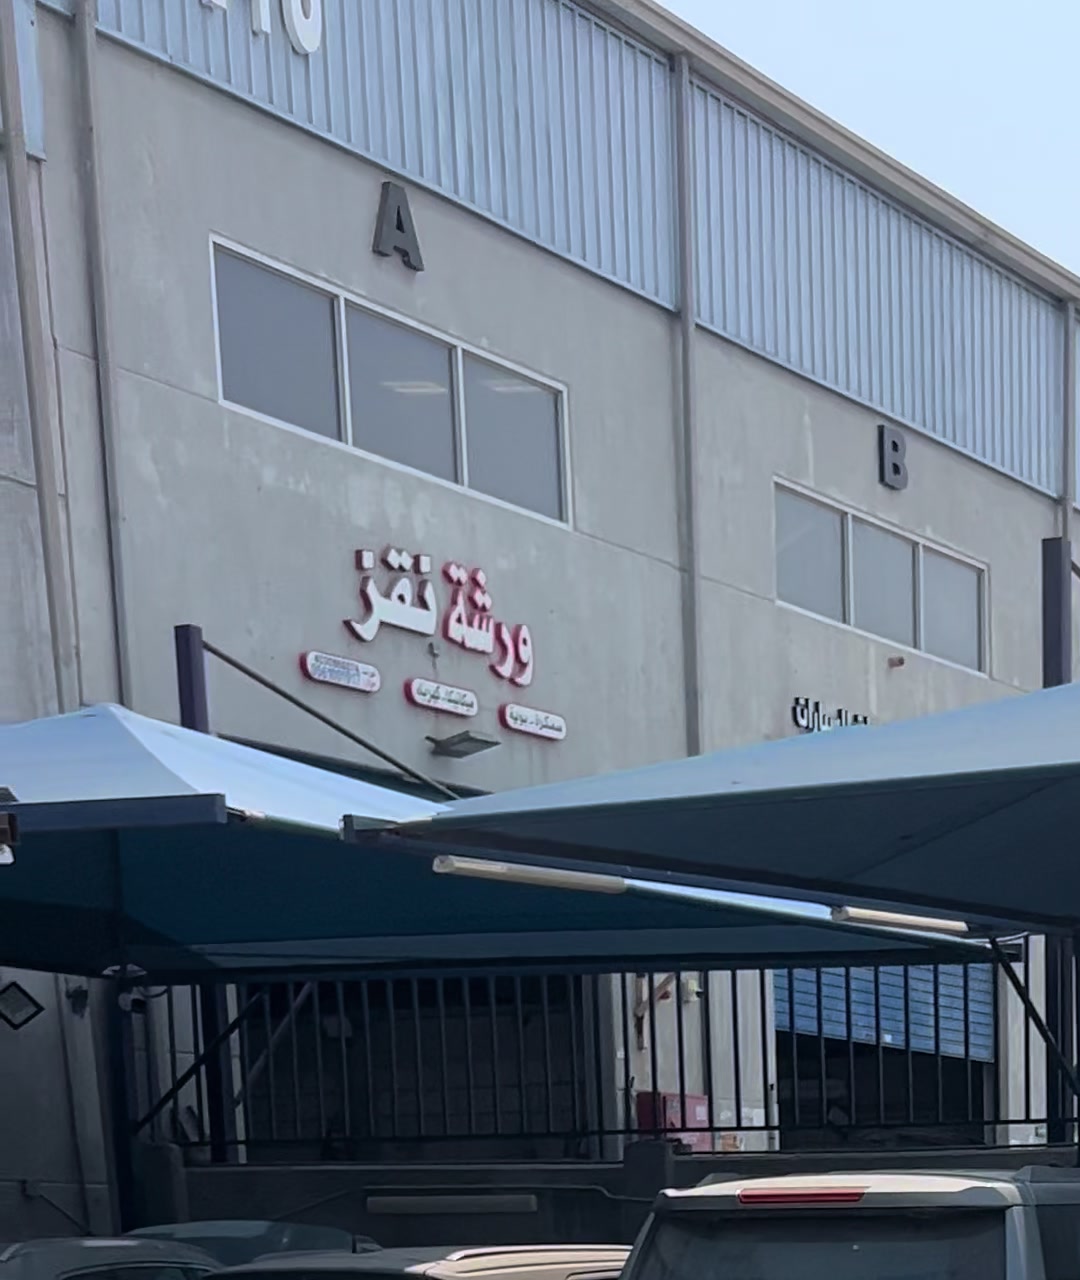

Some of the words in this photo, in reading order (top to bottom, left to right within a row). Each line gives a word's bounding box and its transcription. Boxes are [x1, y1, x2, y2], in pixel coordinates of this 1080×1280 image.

[372, 181, 424, 271] A
[877, 424, 909, 490] B
[442, 561, 533, 686] ورشة
